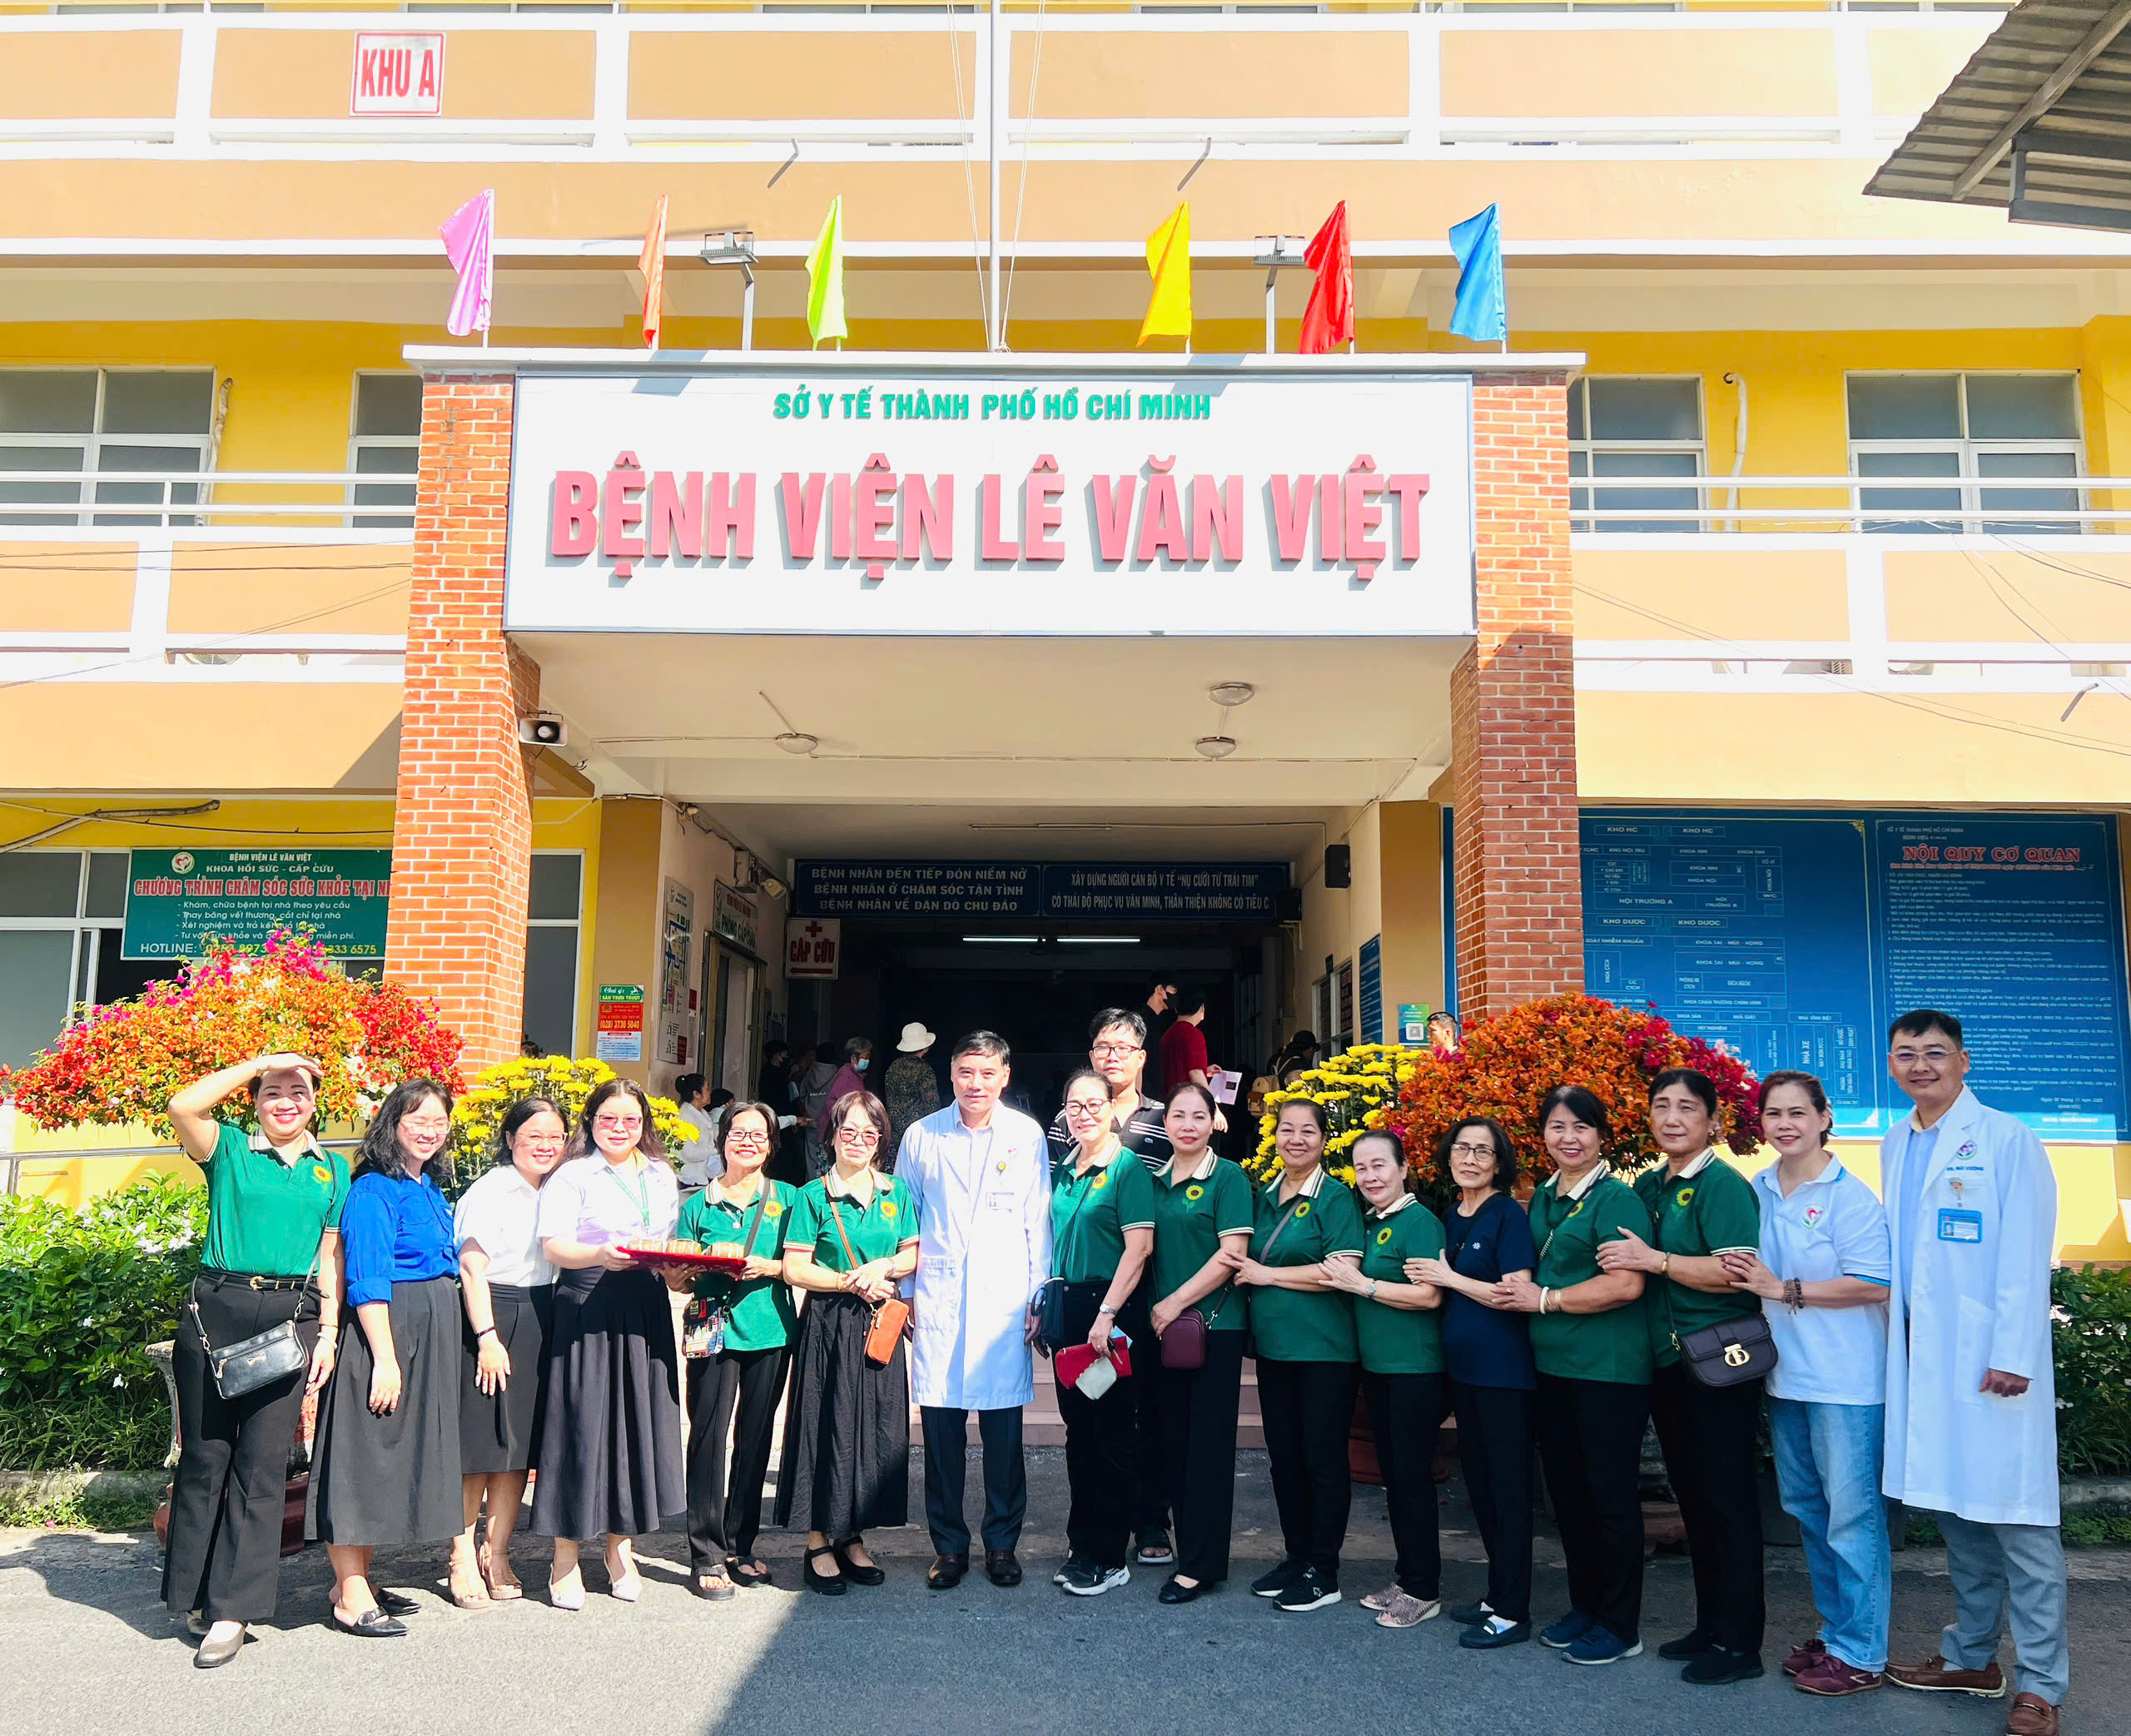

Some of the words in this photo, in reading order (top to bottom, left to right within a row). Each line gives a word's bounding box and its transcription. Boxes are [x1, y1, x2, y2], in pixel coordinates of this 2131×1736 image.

[360, 49, 411, 97] KHU
[418, 49, 435, 97] A
[773, 384, 811, 419] SỞ
[817, 393, 834, 419] Y
[840, 385, 873, 419] TẾ
[880, 389, 969, 419] THÀNH
[981, 387, 1038, 420] PHỐ
[1043, 387, 1079, 420] HỒ
[1085, 389, 1131, 420] CHÍ
[1139, 394, 1210, 420] MINH
[549, 450, 757, 578] BỆNH
[779, 453, 955, 579] VIỆN
[981, 454, 1066, 562] LÊ
[1090, 454, 1244, 562] VĂN
[1269, 454, 1430, 580] VIỆT
[229, 852, 249, 862] BỆNH
[251, 852, 268, 862] VIỆN
[269, 852, 278, 861] LÊ
[280, 852, 295, 861] VĂN
[296, 852, 312, 862] VIỆT
[1902, 843, 1940, 863] NỘI
[1944, 846, 1986, 861] QUY
[1991, 846, 2019, 862] CƠ
[2024, 847, 2080, 862] QUAN
[206, 865, 234, 873] KHOA
[259, 864, 279, 873] SỨC
[812, 867, 845, 880] BỆNH
[849, 867, 882, 879] NHÂN
[886, 866, 912, 879] ĐẾN
[914, 866, 942, 880] TIẾP
[946, 868, 971, 880] ĐÓN
[1070, 870, 1085, 886] XÂY
[1131, 870, 1145, 886] CÁN
[1147, 870, 1157, 889] BỘ
[1159, 874, 1165, 886] Y
[1165, 869, 1176, 886] TẾ
[1211, 870, 1223, 887] TỪ
[1224, 870, 1239, 886] TRÁI
[134, 875, 182, 896] CHƯƠNG
[185, 875, 223, 896] TRÌNH
[226, 875, 260, 896] CHĂM
[263, 875, 287, 896] SÓC
[290, 875, 315, 896] SỨC
[316, 874, 350, 896] KHỎE
[353, 880, 375, 900] TẠI
[814, 882, 847, 895] BỆNH
[852, 883, 885, 894] NHÂN
[888, 881, 898, 895] Ở
[940, 883, 964, 895] SÓC
[995, 884, 1023, 895] TÌNH
[183, 900, 211, 910] Khám,
[213, 900, 235, 909] chữa
[237, 900, 259, 910] bệnh
[261, 901, 272, 910] tại
[315, 901, 330, 910] yêu
[819, 898, 852, 911] BỆNH
[857, 899, 891, 910] NHÂN
[943, 899, 960, 910] DÒ
[964, 900, 988, 910] CHU
[992, 899, 1017, 911] ĐÁO
[1063, 892, 1080, 908] THÁI
[1094, 895, 1112, 910] PHỤC
[1115, 895, 1124, 910] VỤ
[1125, 893, 1140, 908] VĂN
[1165, 893, 1182, 909] THÂN
[1185, 892, 1206, 911] THIỆN
[1208, 893, 1232, 909] KHÔNG
[1234, 894, 1244, 909] CÓ
[1245, 893, 1262, 910] TIÊU
[183, 911, 202, 920] Thay
[311, 911, 322, 920] tại
[199, 921, 231, 930] nghiệm
[246, 920, 257, 929] trả
[141, 943, 197, 954] HOTLINE:
[350, 945, 376, 955] 6575
[790, 937, 811, 962] CẤP
[814, 938, 835, 963] CỨU
[1801, 1040, 1810, 1049] XE
[1801, 1050, 1811, 1064] NHÀ
